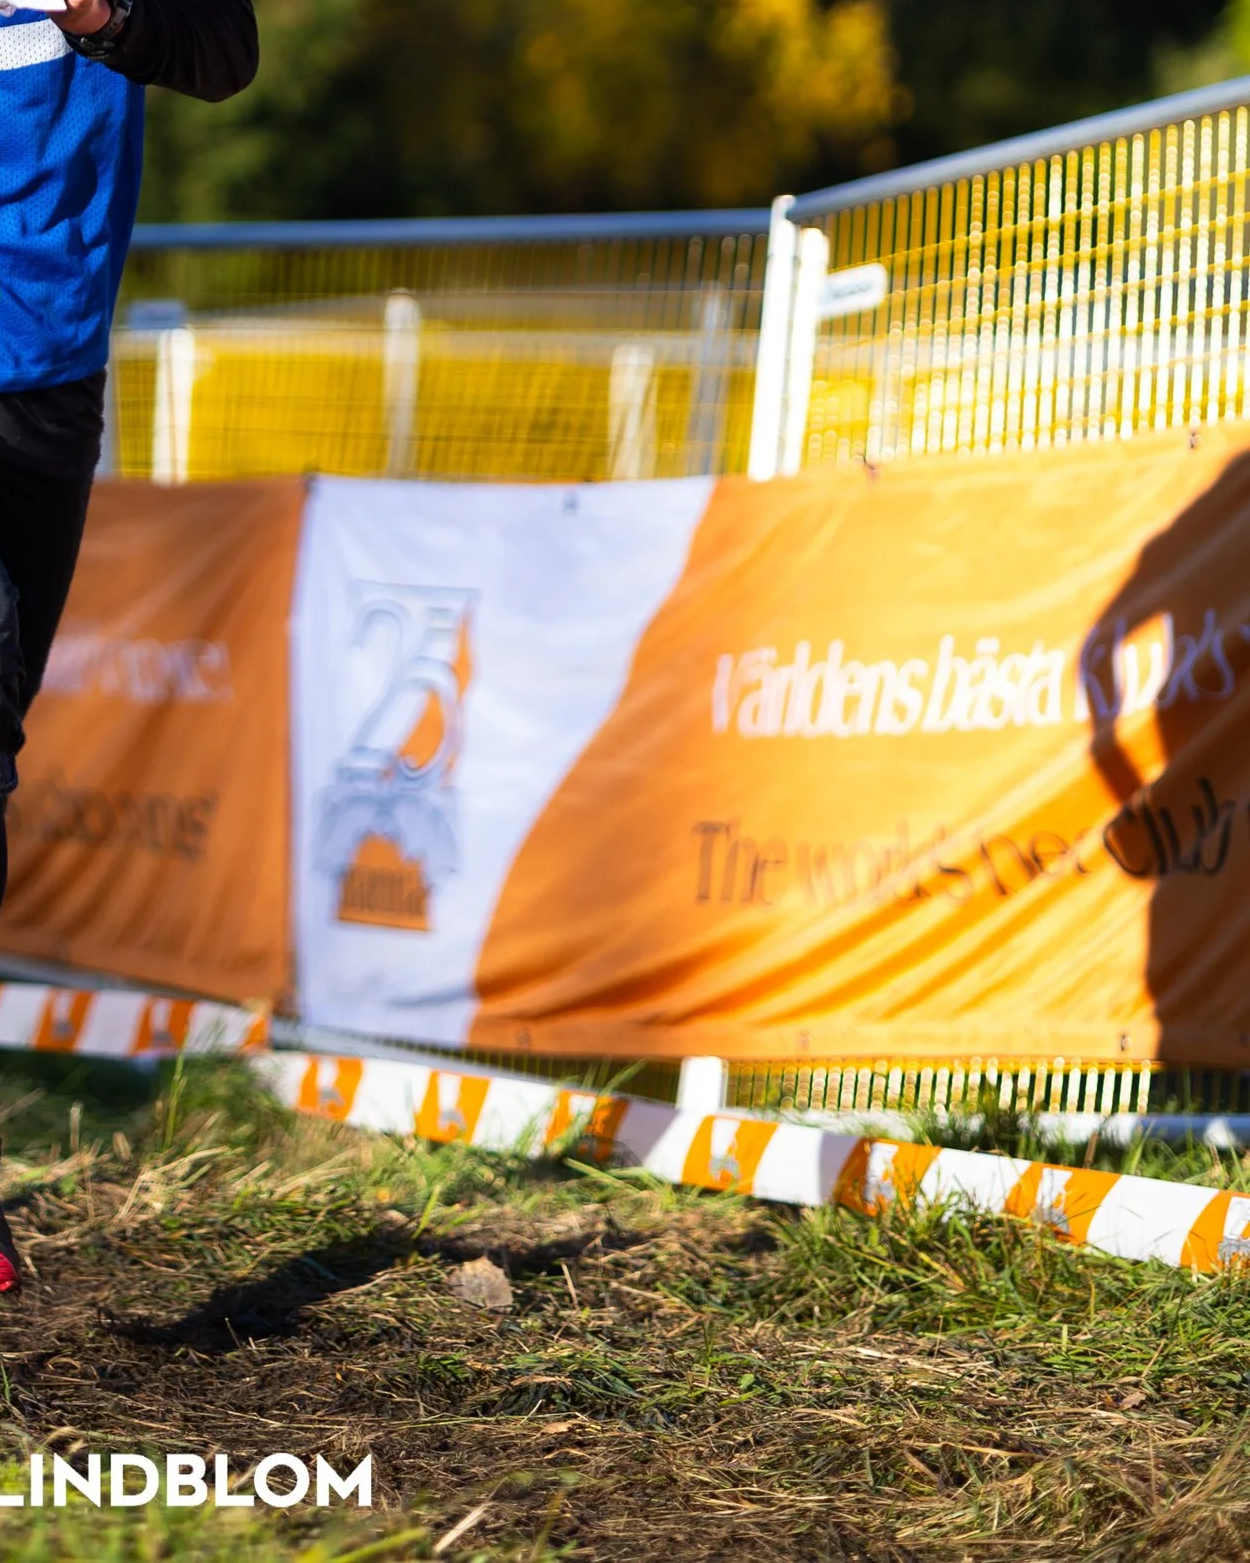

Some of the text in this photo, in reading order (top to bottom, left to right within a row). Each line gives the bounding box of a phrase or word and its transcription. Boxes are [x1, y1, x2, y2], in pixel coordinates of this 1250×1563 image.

[711, 638, 930, 738] Världens
[920, 634, 1068, 735] bästa
[691, 819, 786, 906] The
